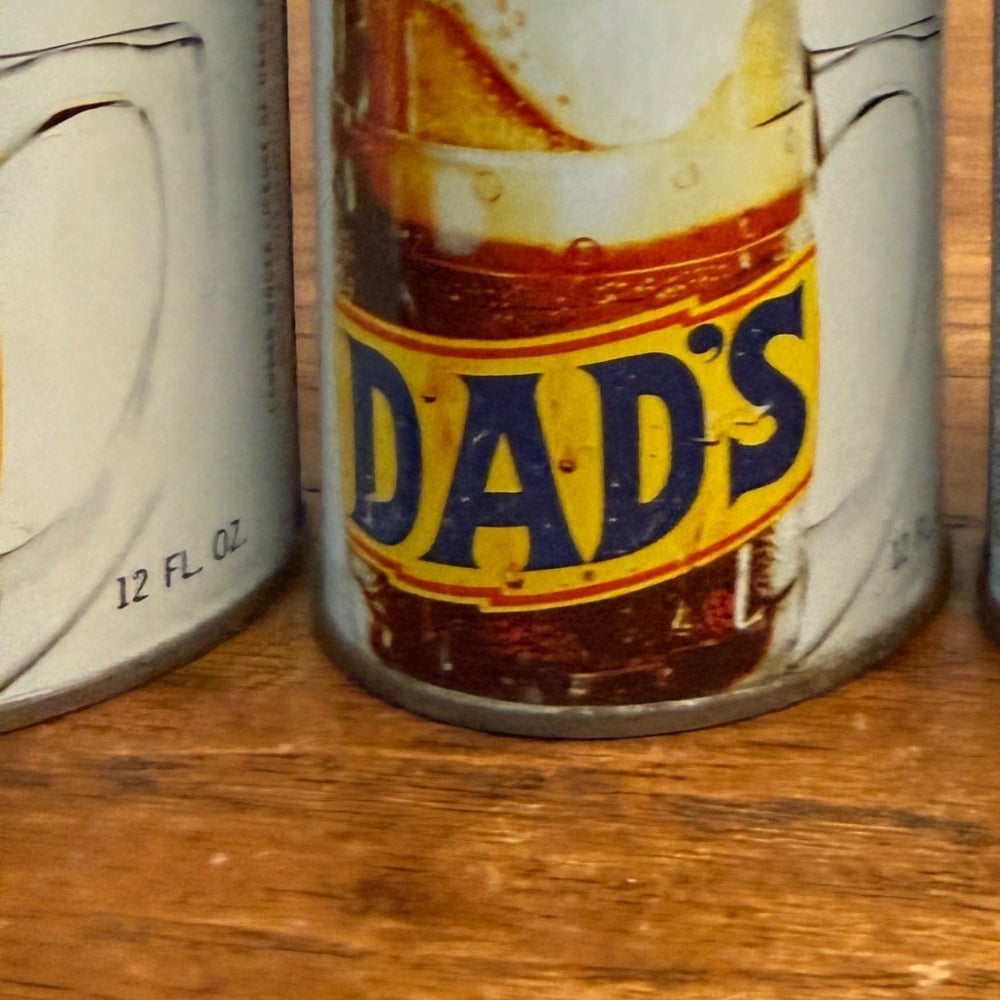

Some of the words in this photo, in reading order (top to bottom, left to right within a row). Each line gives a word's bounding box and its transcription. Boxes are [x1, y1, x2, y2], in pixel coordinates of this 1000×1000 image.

[347, 281, 810, 570] DAD'S
[116, 567, 149, 609] 12
[212, 518, 248, 561] OZ
